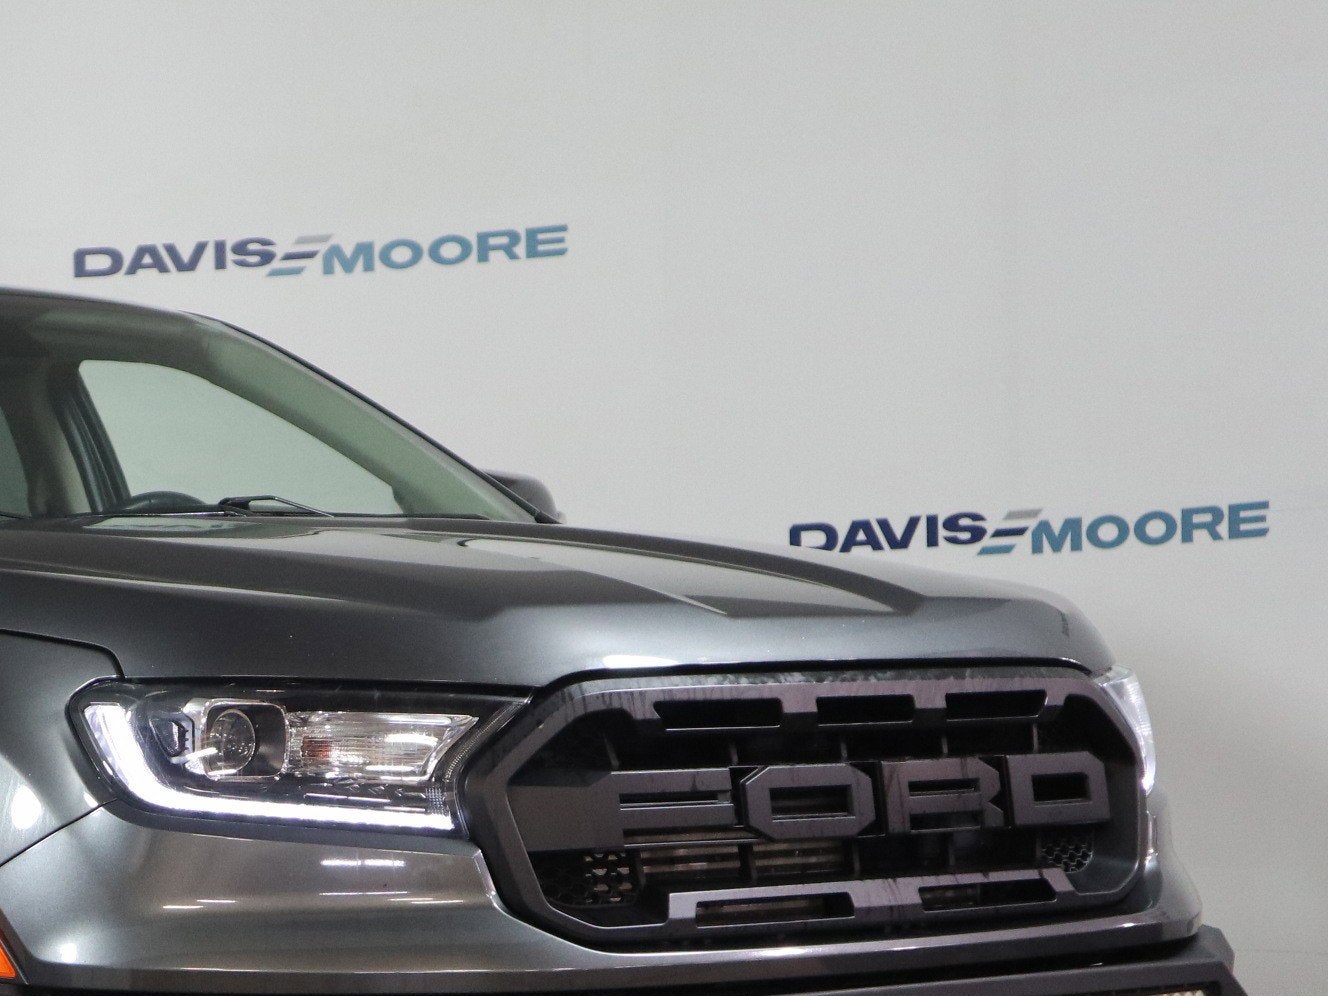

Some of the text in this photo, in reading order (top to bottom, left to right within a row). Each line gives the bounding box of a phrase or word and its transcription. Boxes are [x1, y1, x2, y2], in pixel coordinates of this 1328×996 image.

[73, 224, 568, 278] DAVIS MOORE
[788, 500, 1270, 555] DAVIS MOORE
[607, 750, 1110, 848] FORD
